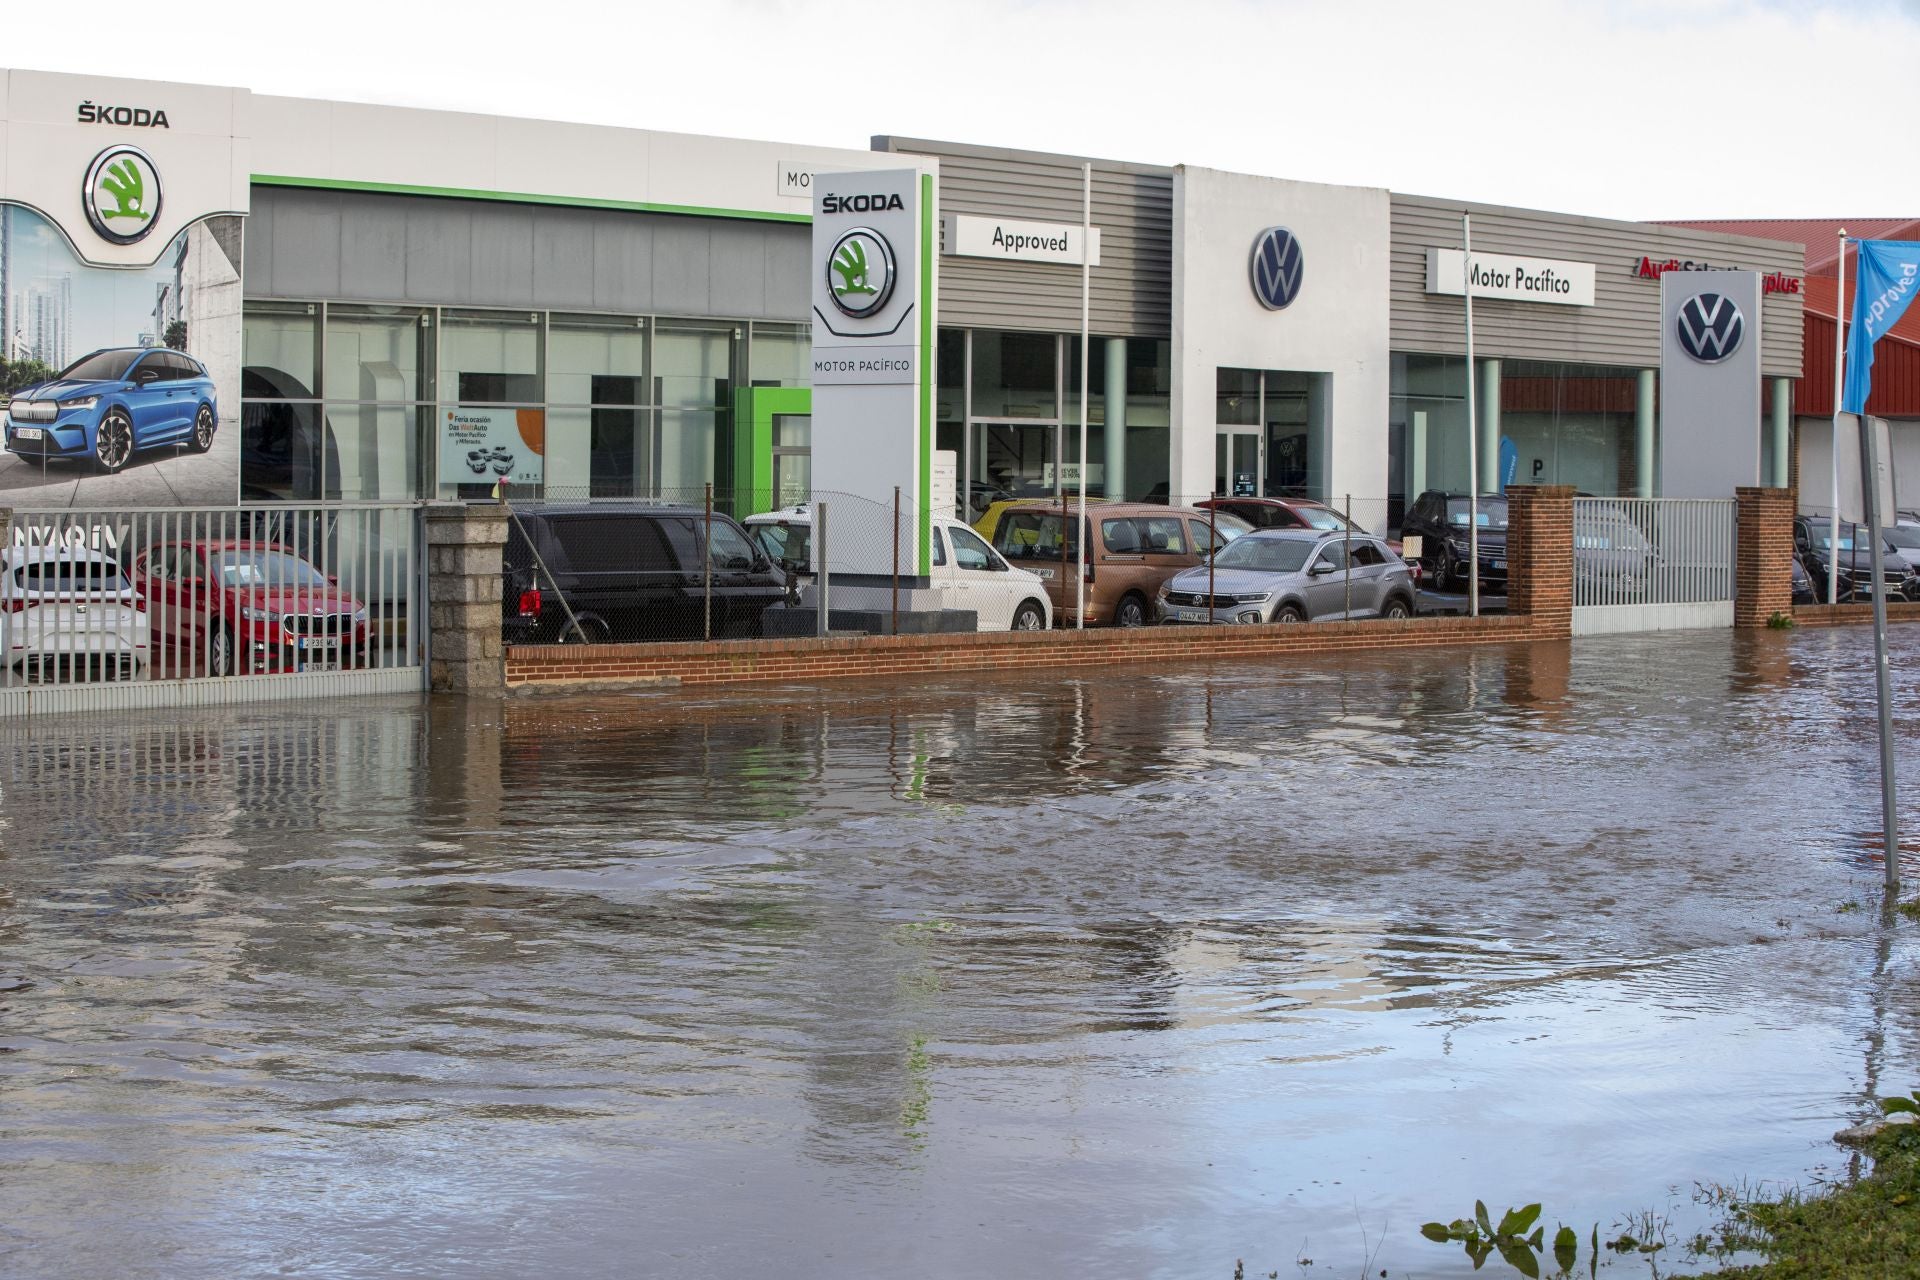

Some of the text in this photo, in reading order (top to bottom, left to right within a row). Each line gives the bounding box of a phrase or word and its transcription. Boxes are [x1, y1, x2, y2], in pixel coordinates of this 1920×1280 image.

[77, 100, 170, 129] ŠKODA
[787, 171, 814, 188] MO
[822, 193, 905, 214] ŠKODA
[992, 226, 1068, 253] Approved
[1470, 263, 1570, 294] Motor Pacífico
[814, 357, 910, 372] MOTOR PACÍFICO
[1533, 459, 1543, 477] P
